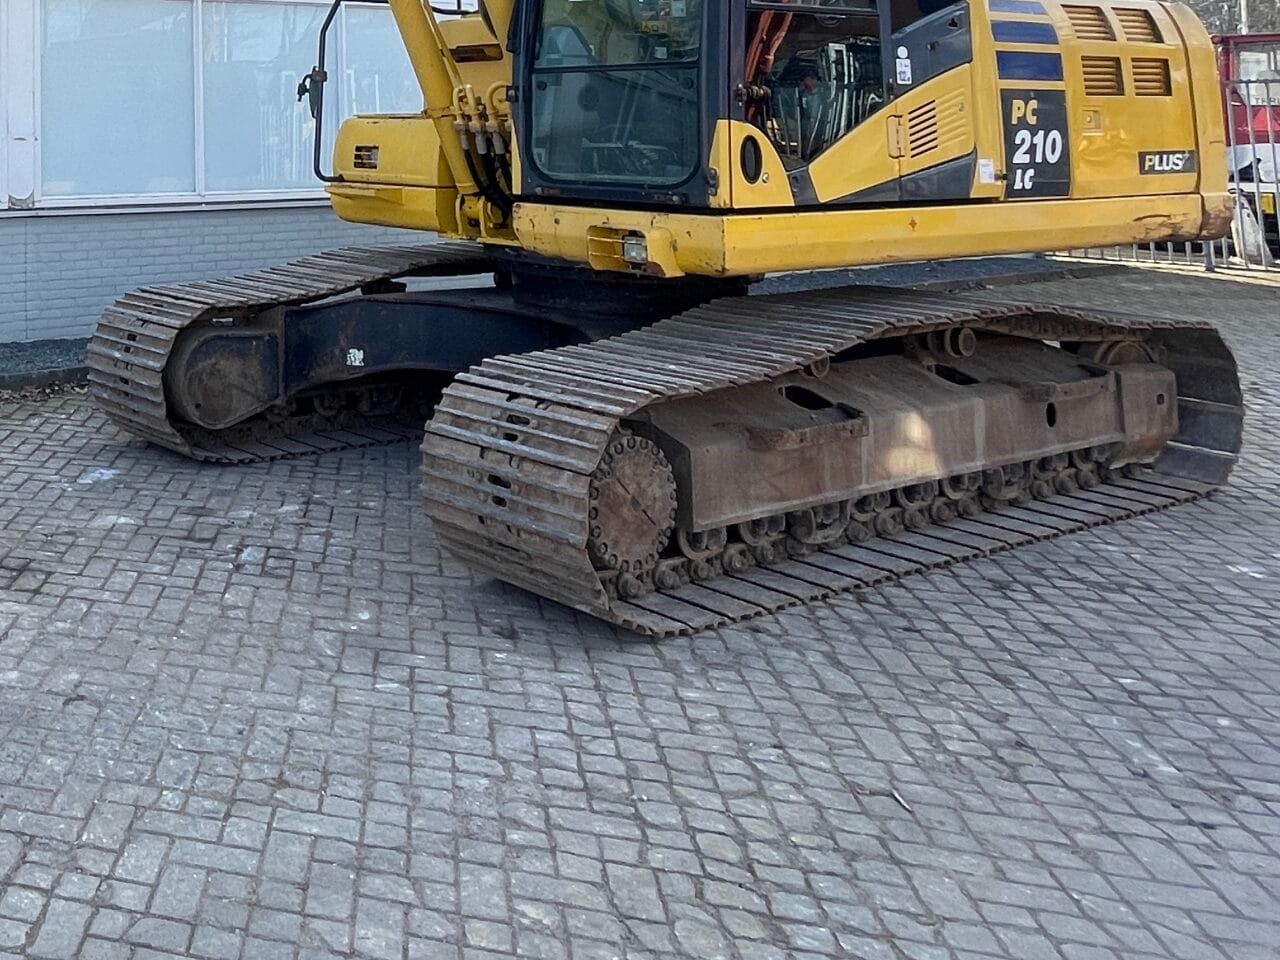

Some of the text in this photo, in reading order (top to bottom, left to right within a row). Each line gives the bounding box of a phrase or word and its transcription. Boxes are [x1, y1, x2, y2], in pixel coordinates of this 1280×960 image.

[1011, 99, 1038, 125] PC
[1012, 129, 1063, 164] 210
[1013, 168, 1035, 190] LC
